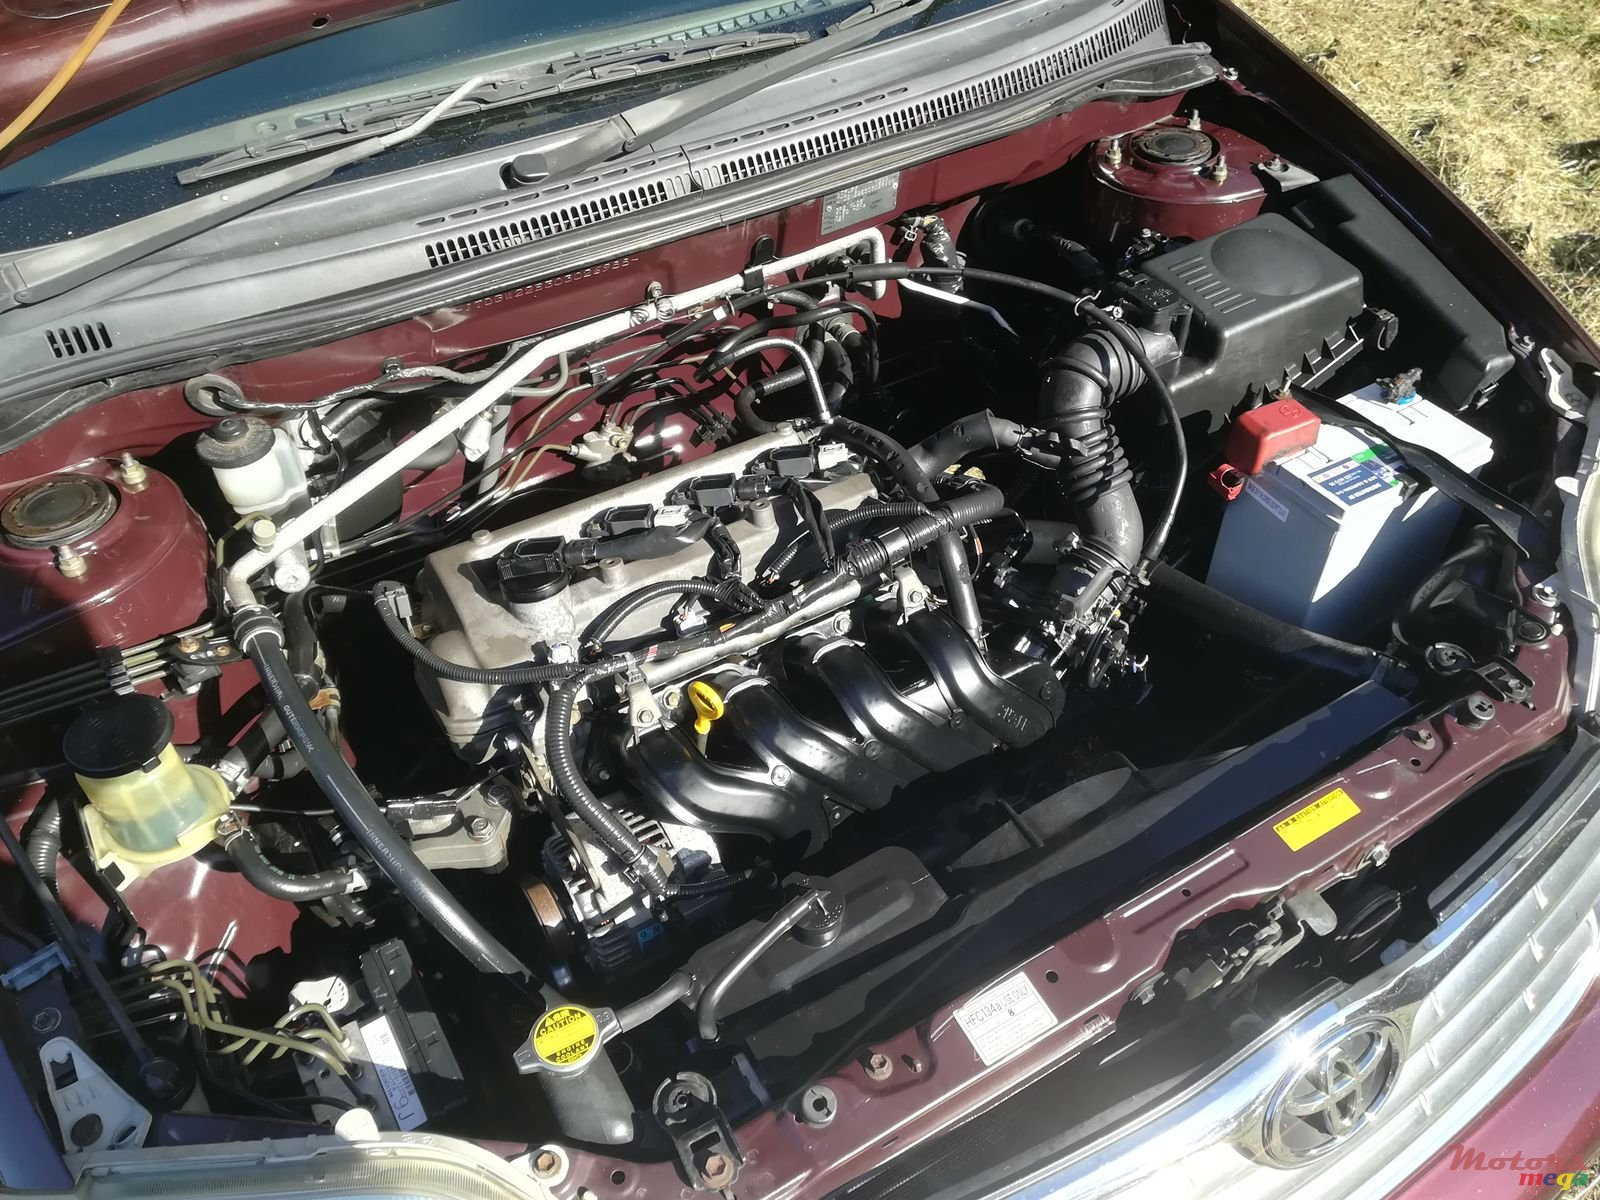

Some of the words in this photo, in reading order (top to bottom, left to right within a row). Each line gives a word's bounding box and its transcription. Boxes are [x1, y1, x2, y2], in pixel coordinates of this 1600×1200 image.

[964, 1002, 1002, 1029] HFC134a
[1007, 1008, 1015, 1017] 8
[540, 1012, 581, 1036] CAUTION
[555, 1040, 585, 1057] ENGINE
[555, 1042, 590, 1062] COOLANT
